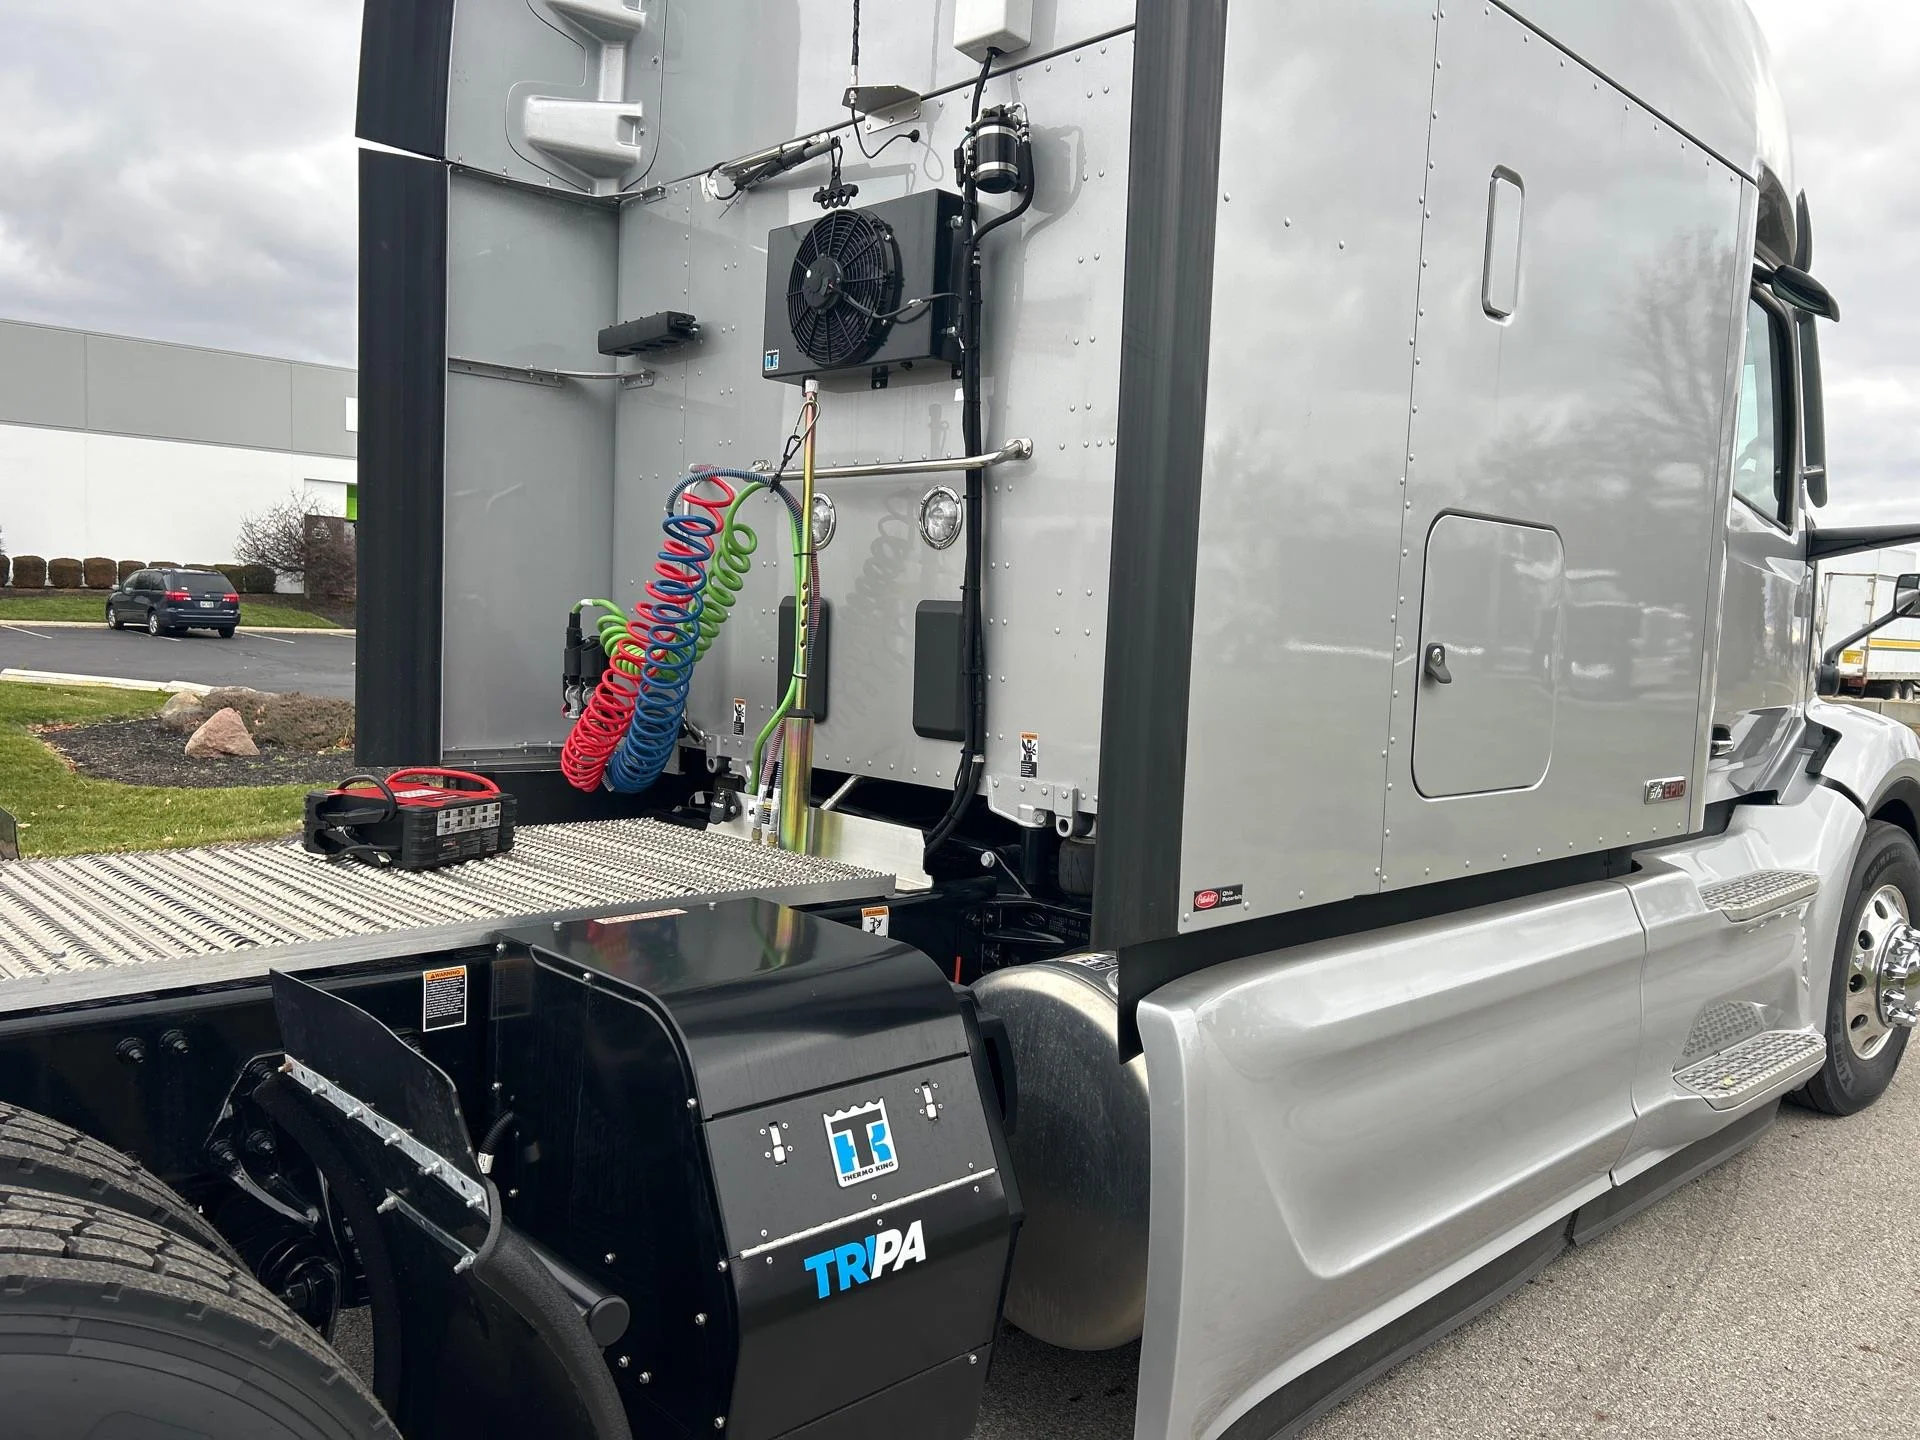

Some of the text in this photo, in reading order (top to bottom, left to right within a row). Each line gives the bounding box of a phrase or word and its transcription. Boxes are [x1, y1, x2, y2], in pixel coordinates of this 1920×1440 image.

[434, 970, 461, 978] WARNING
[843, 1161, 895, 1182] THERMO KING
